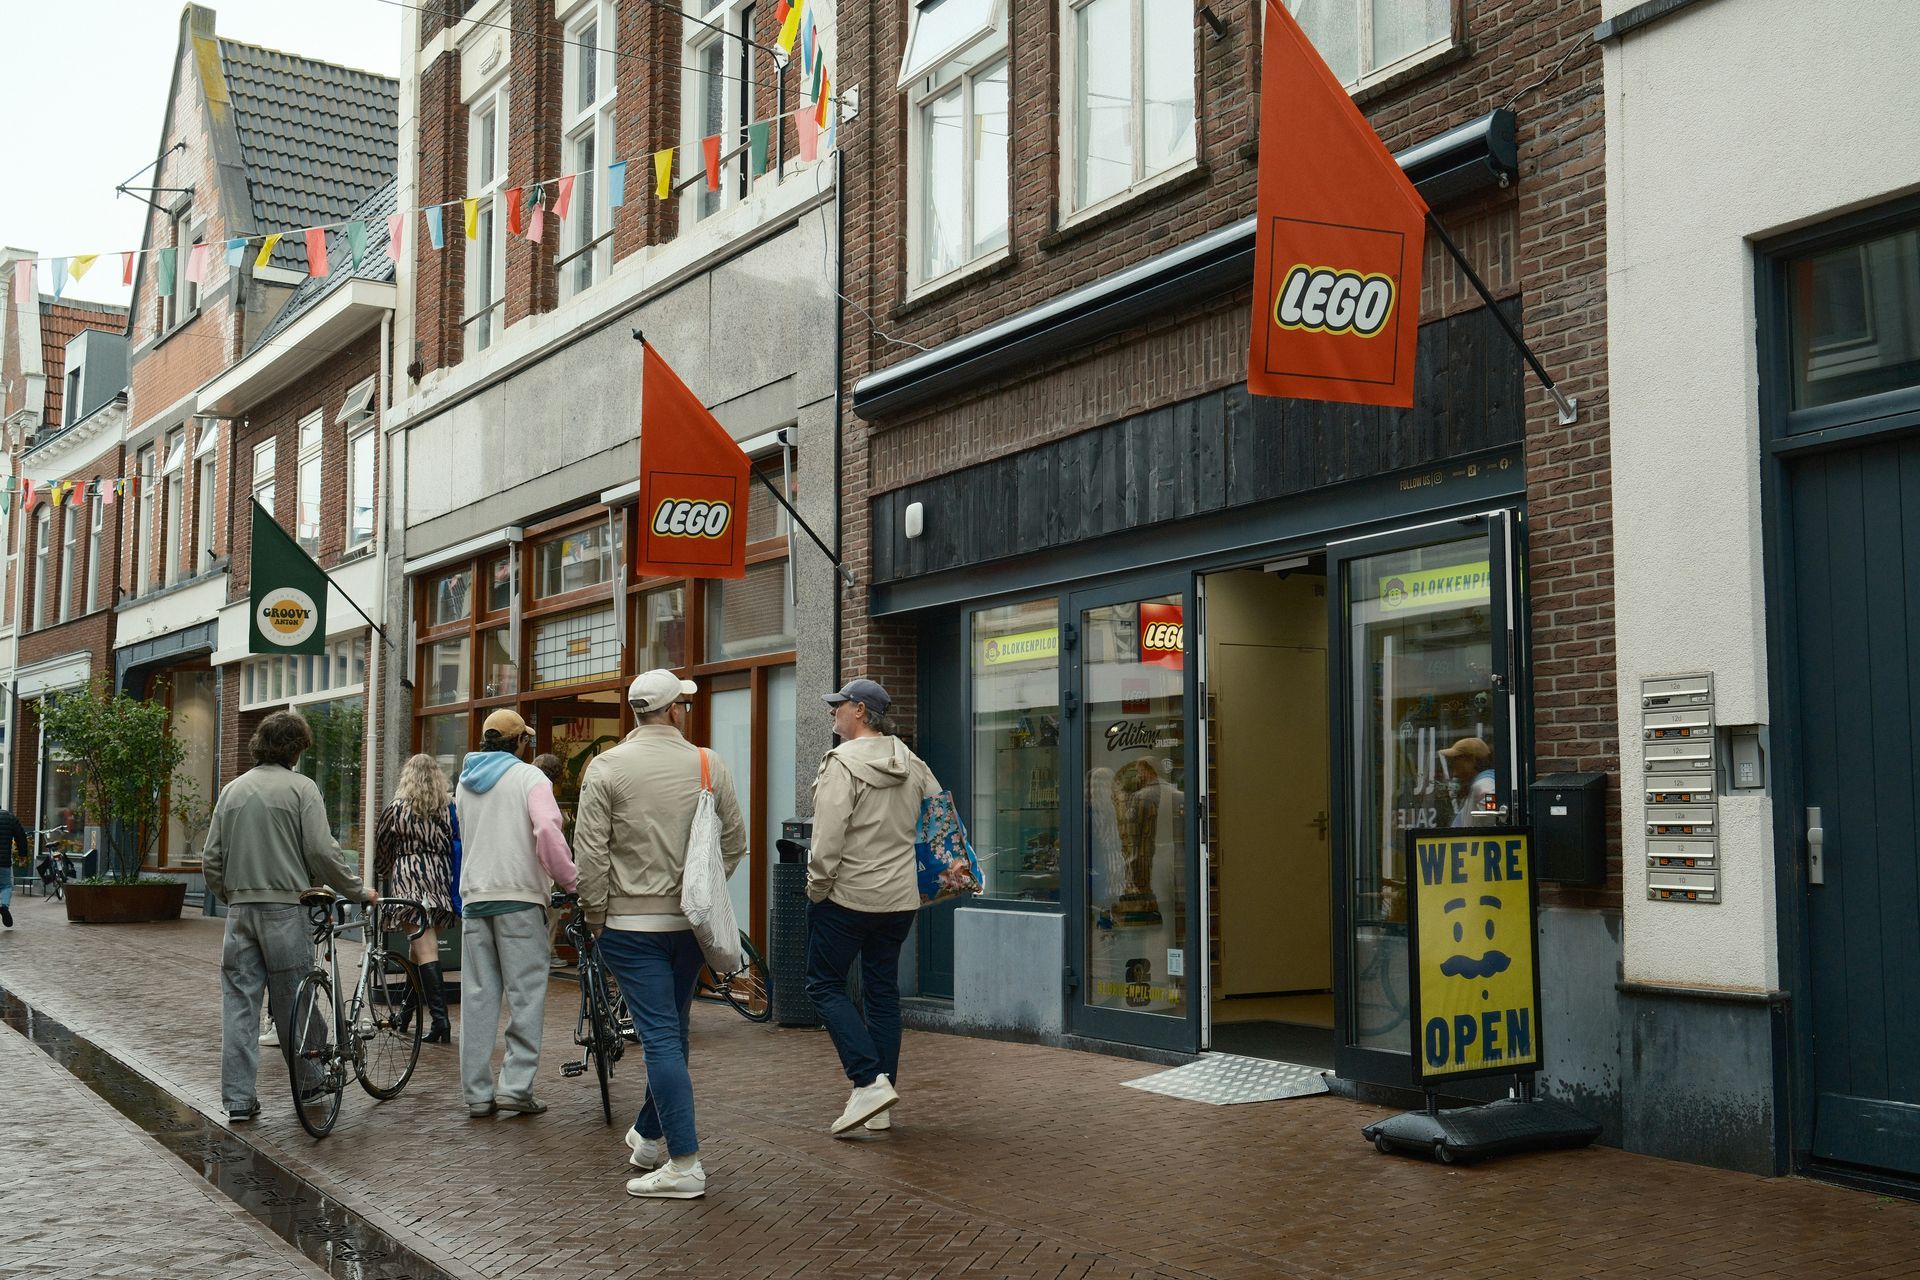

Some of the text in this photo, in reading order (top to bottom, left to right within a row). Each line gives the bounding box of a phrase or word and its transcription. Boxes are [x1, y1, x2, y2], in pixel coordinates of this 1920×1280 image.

[1276, 266, 1393, 335] LEGO
[1399, 475, 1431, 490] FOLLOW US
[653, 499, 729, 538] LEGO
[262, 607, 312, 619] GROOVY
[1418, 839, 1523, 886] WE'RE
[1425, 1007, 1530, 1068] OPEN
